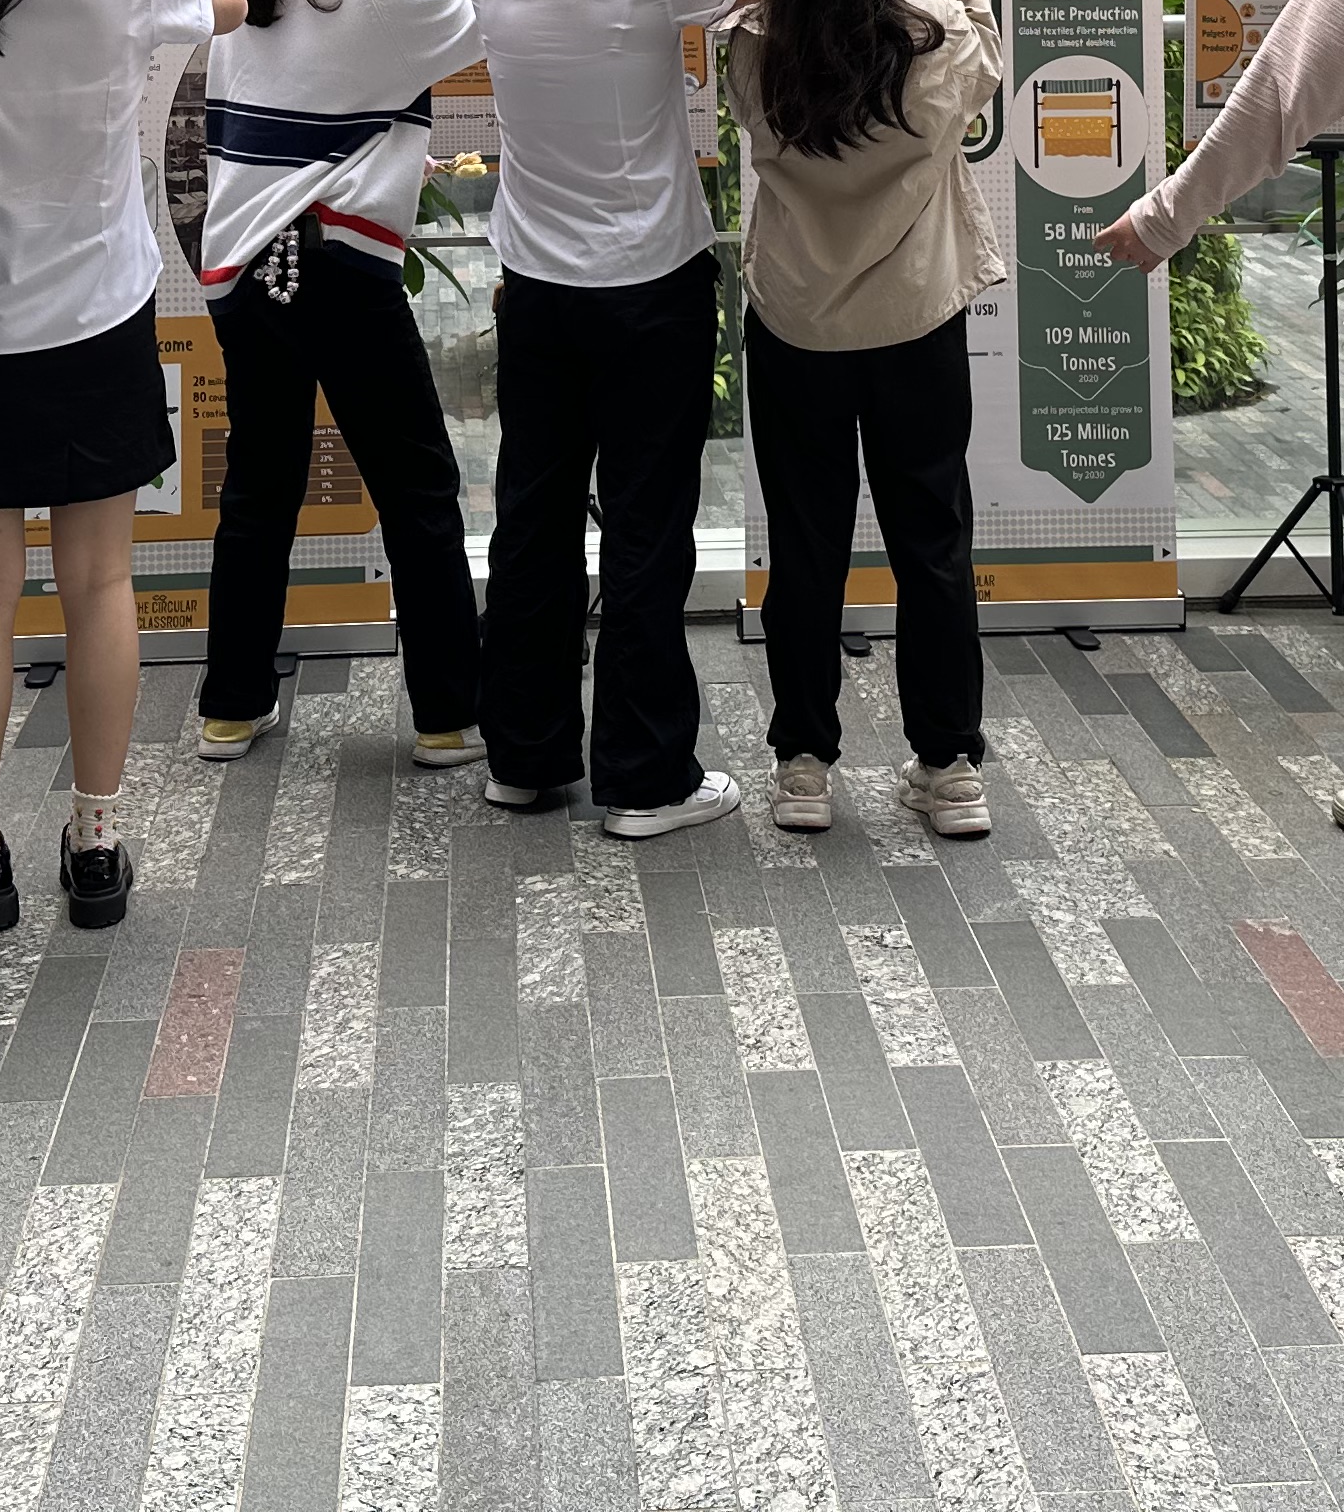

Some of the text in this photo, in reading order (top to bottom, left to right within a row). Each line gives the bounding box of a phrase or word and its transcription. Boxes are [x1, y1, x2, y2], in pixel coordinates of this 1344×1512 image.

[1020, 7, 1138, 21] Textile Production
[1045, 224, 1065, 240] 58
[1057, 249, 1112, 267] Tonnes
[1046, 327, 1130, 344] 109 Million
[1061, 354, 1115, 370] Tonnes
[1047, 423, 1129, 440] 125 Million
[1061, 450, 1115, 467] Tonnes
[1073, 471, 1104, 481] by 2030
